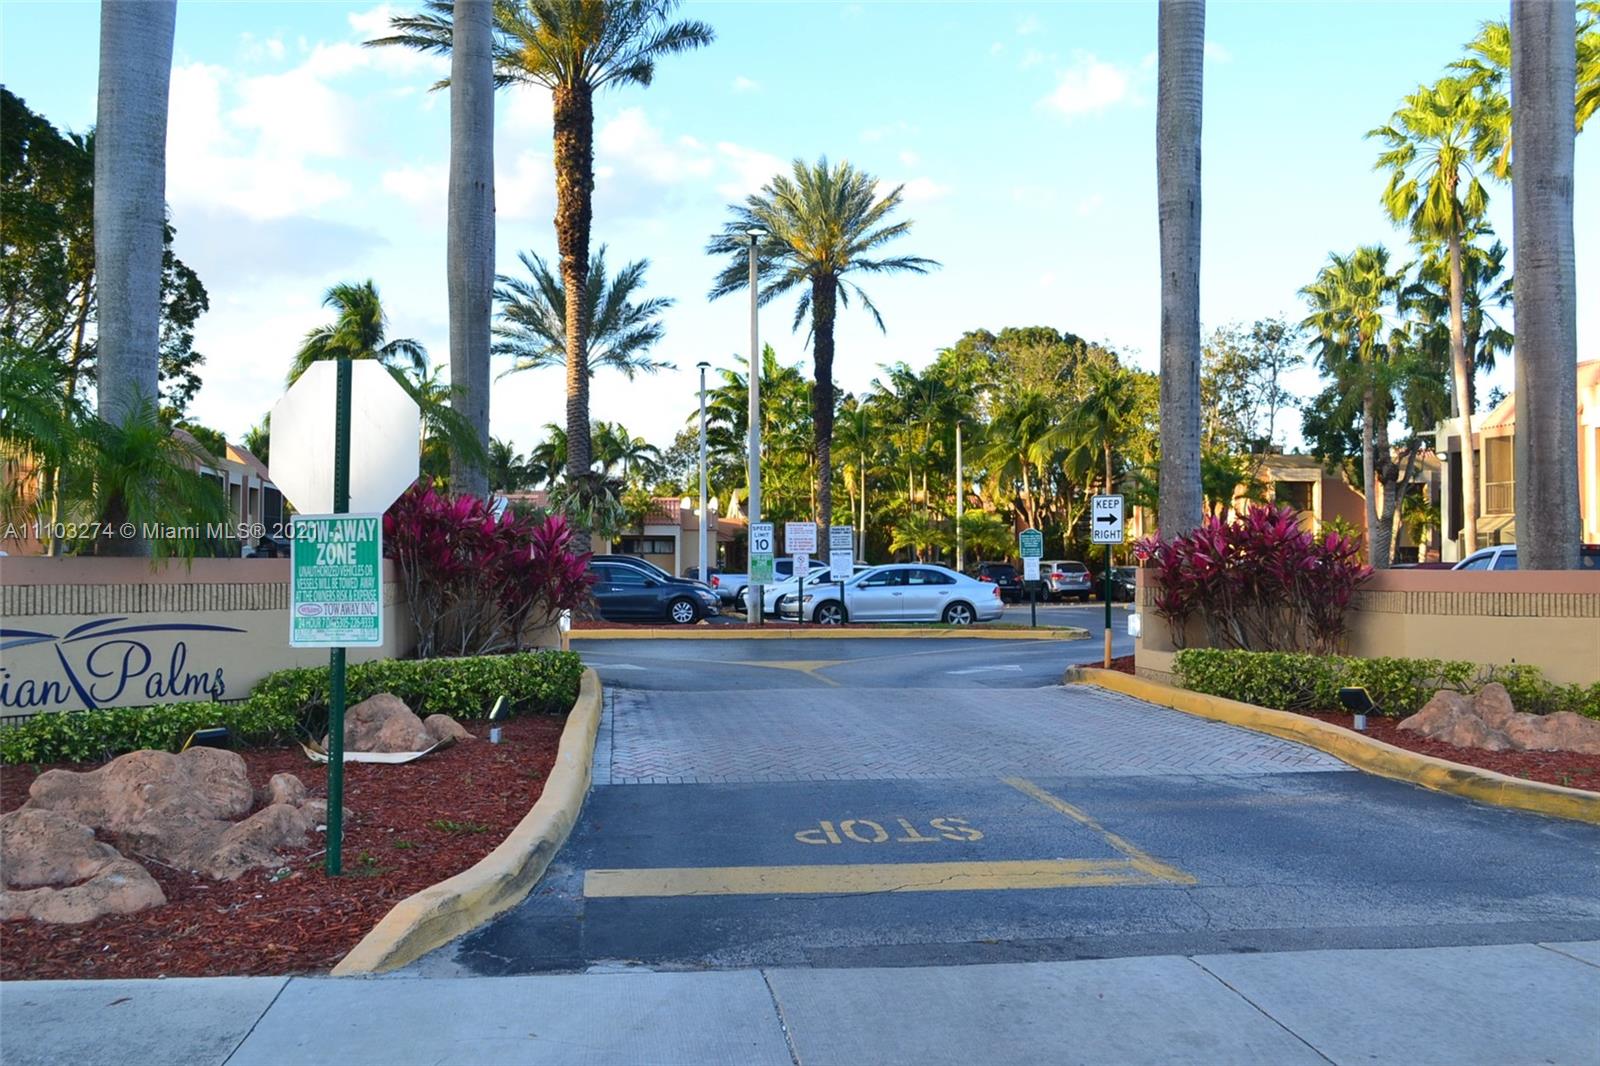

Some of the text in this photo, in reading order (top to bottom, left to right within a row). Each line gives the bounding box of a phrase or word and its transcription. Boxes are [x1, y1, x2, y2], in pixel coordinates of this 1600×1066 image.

[1096, 499, 1119, 509] KEEP
[296, 519, 376, 543] TOW-AWAY
[1094, 529, 1121, 539] RIGHT
[755, 539, 769, 550] 10
[316, 543, 357, 565] ZONE
[299, 565, 373, 577] UNAUTHORIZED VEHICLES OR
[297, 577, 375, 590] VESSELS WILL BE TOWED AWAY
[296, 590, 302, 602] AT
[302, 590, 313, 602] THE
[314, 590, 336, 602] OWNERS
[336, 590, 348, 601] RISK
[354, 590, 376, 601] EXPENSE
[324, 603, 340, 615] TOW
[340, 603, 360, 615] AWAY
[304, 618, 320, 628] HOUR
[0, 640, 226, 708] ian Palms
[794, 816, 984, 844] STOP
